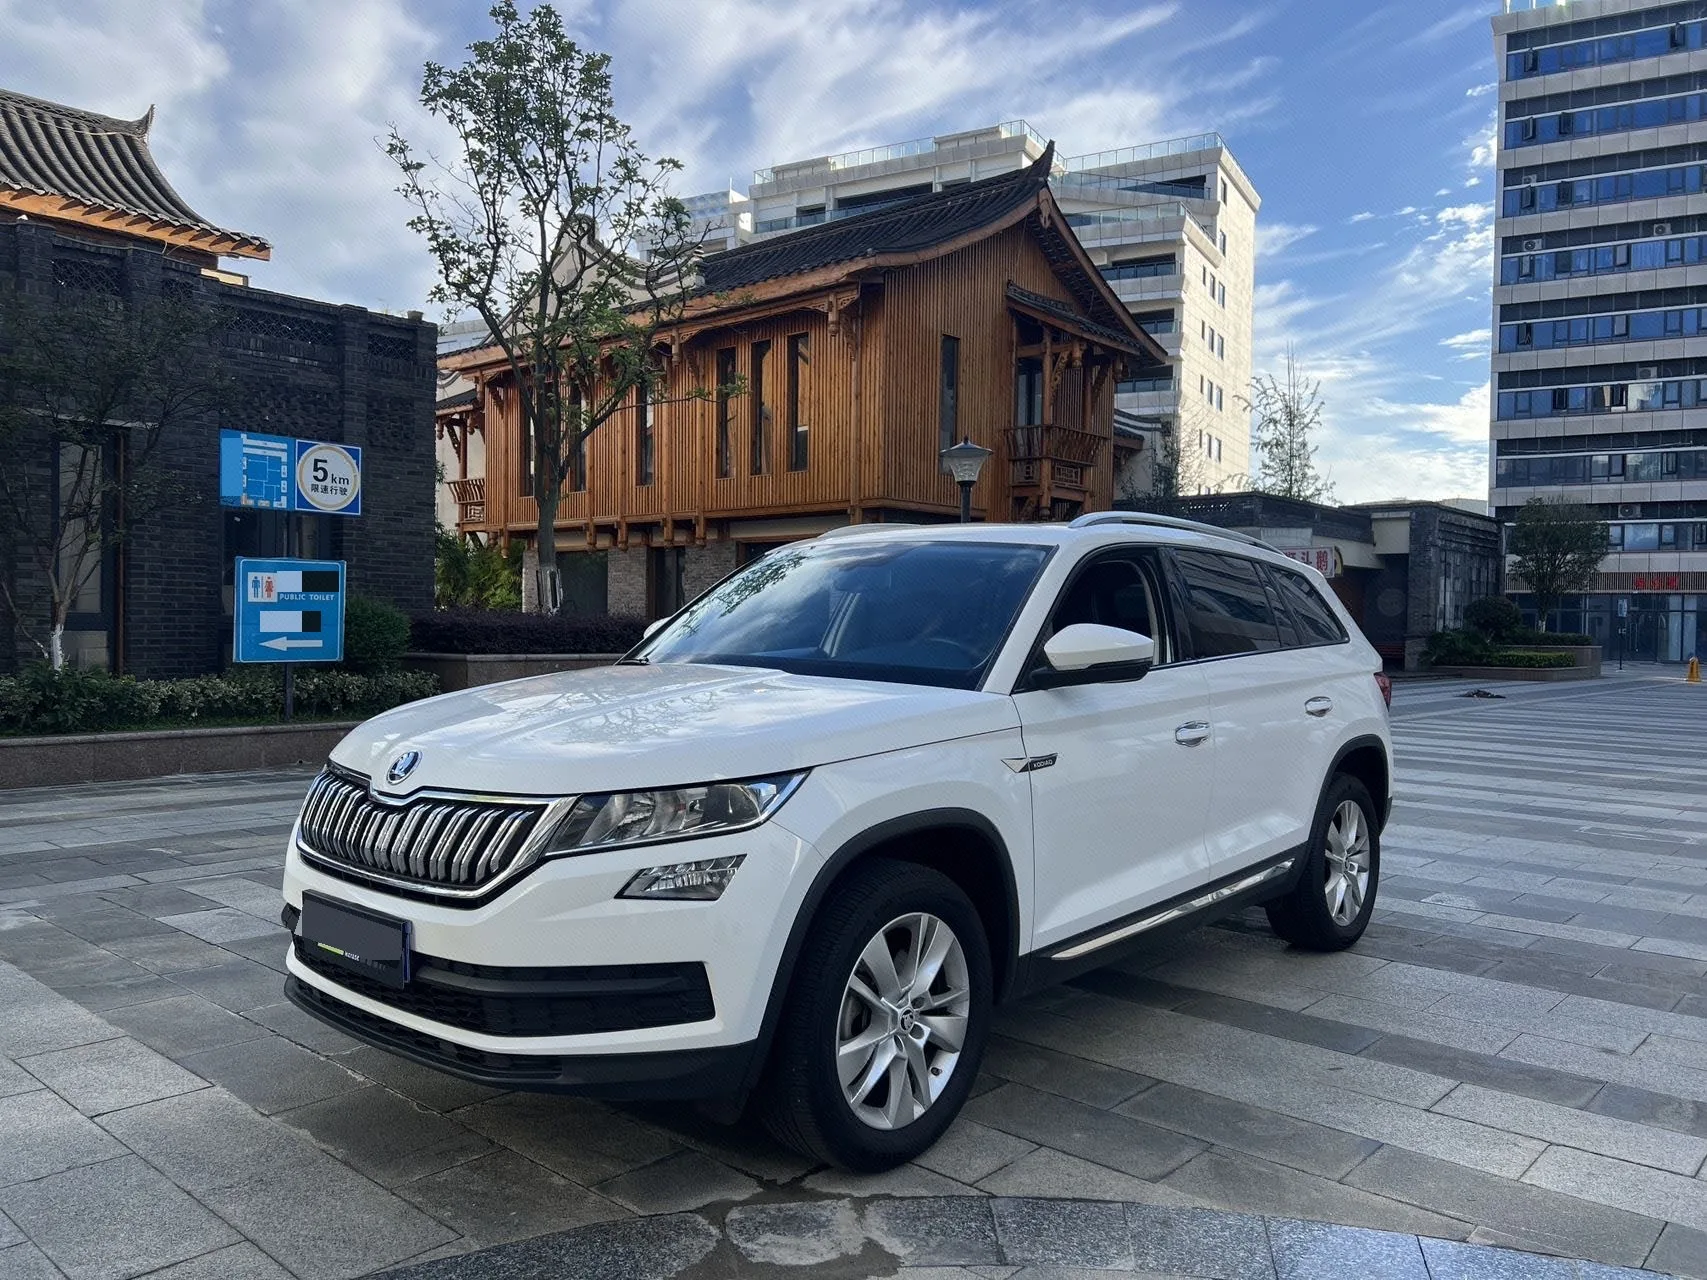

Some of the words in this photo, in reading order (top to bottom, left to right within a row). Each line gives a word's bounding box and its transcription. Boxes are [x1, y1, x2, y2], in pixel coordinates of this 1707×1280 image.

[313, 458, 328, 482] 5
[331, 473, 350, 485] km
[310, 483, 348, 496] 限速行驶
[280, 593, 306, 601] PUBLIC
